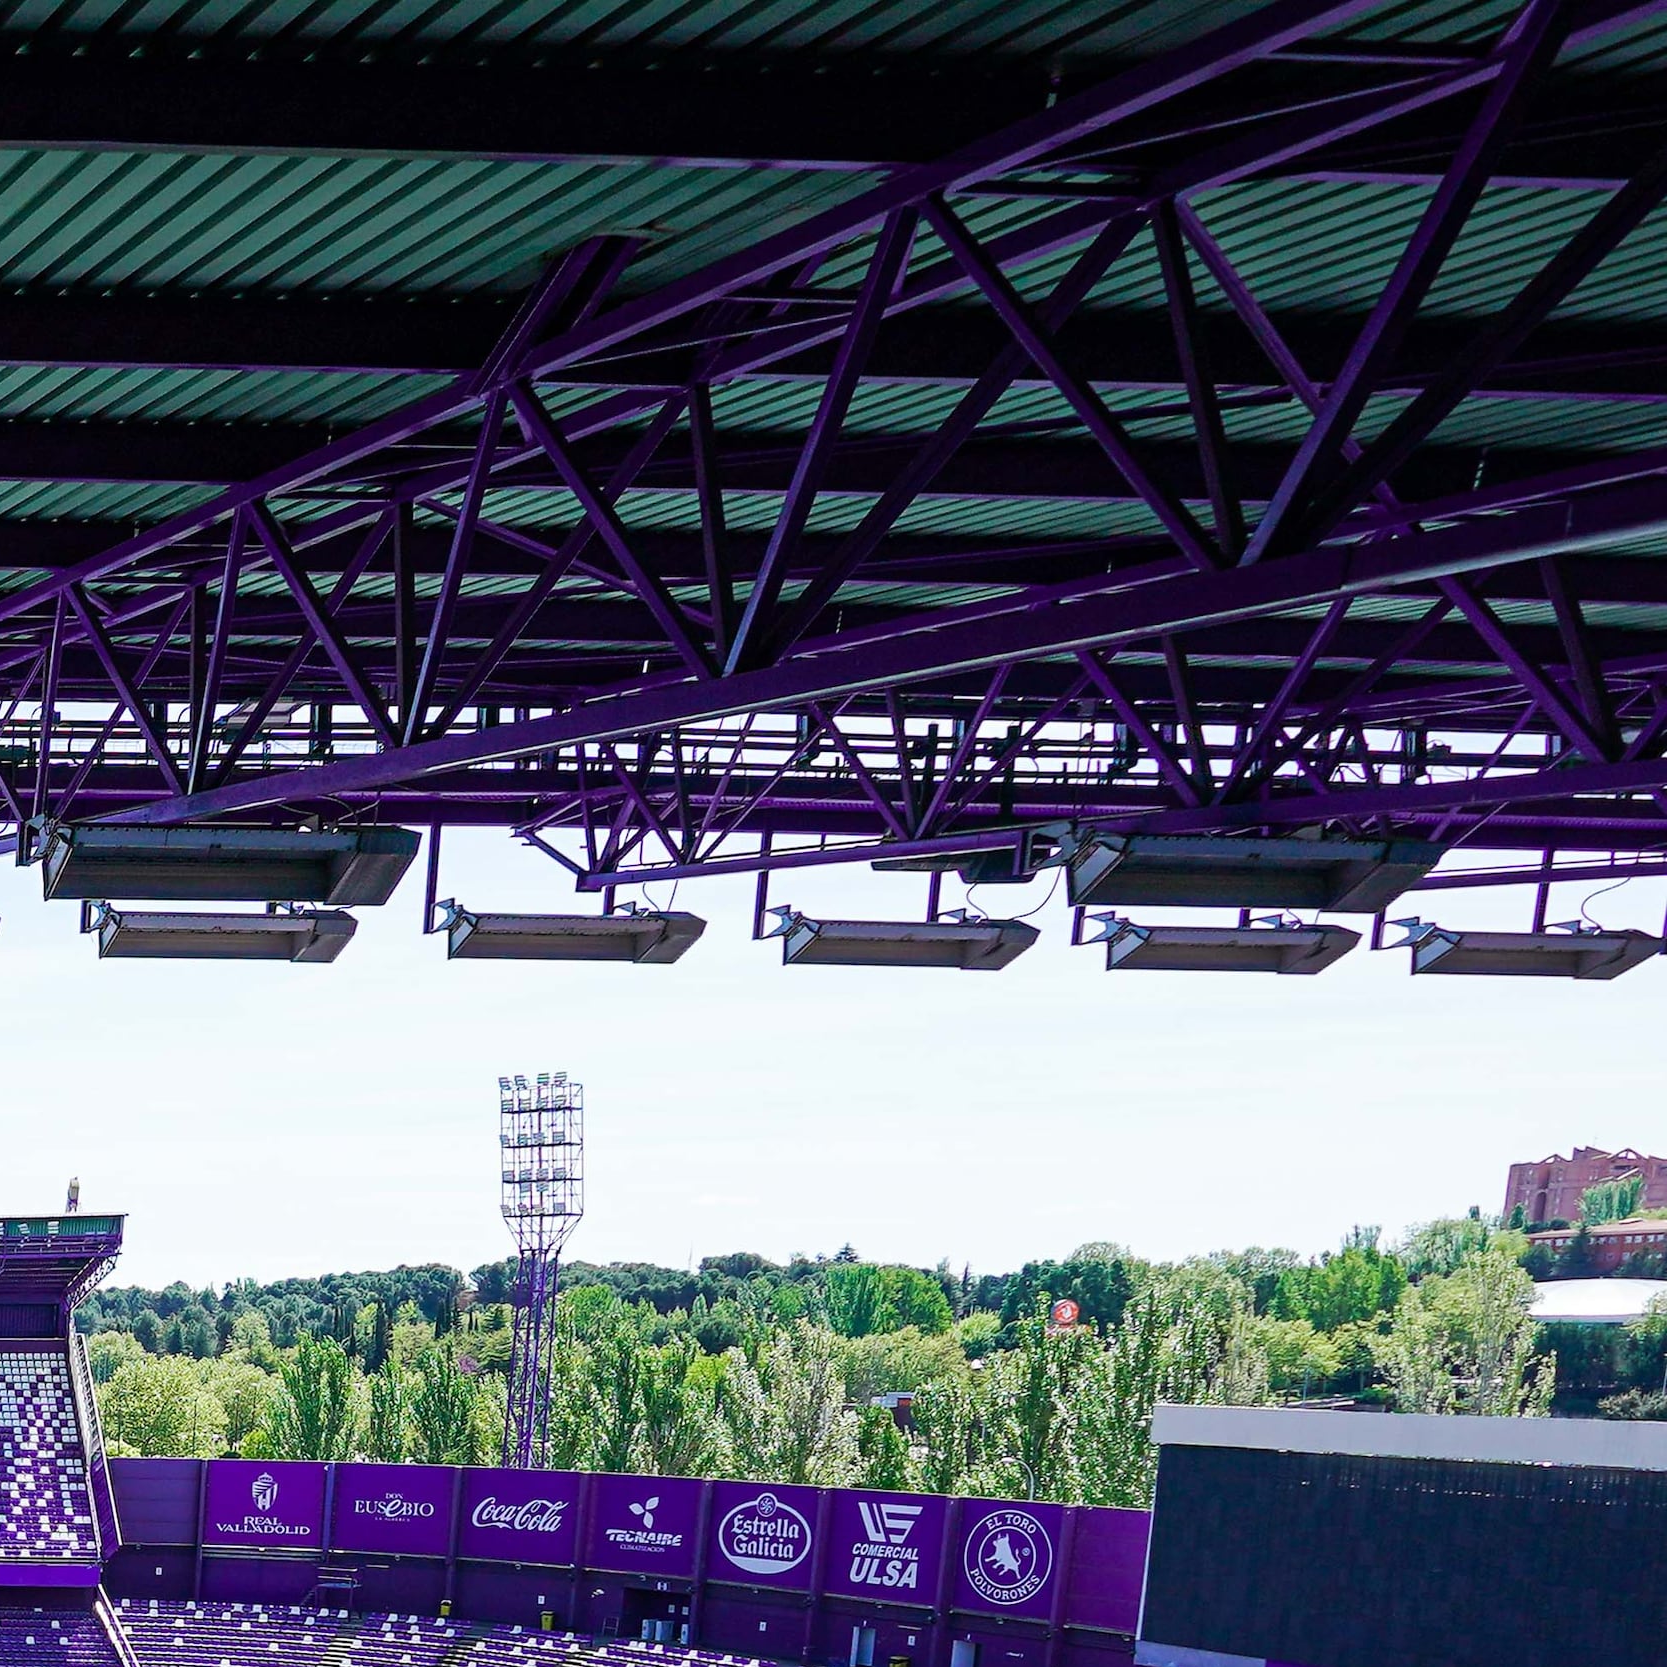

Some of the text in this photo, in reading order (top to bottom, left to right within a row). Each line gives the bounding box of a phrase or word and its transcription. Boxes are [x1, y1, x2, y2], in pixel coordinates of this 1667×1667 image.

[243, 1515, 281, 1526] REAL
[472, 1496, 569, 1532] Coca-Cola
[985, 1514, 1037, 1534] EL TORO
[215, 1523, 311, 1536] VALLADOLID
[731, 1514, 800, 1539] Estrella
[605, 1529, 683, 1547] TECNAIRE
[733, 1534, 795, 1559] Galicia
[852, 1542, 919, 1560] COMERCIAL
[849, 1556, 918, 1588] ULSA
[970, 1567, 1041, 1600] POLVORONES
